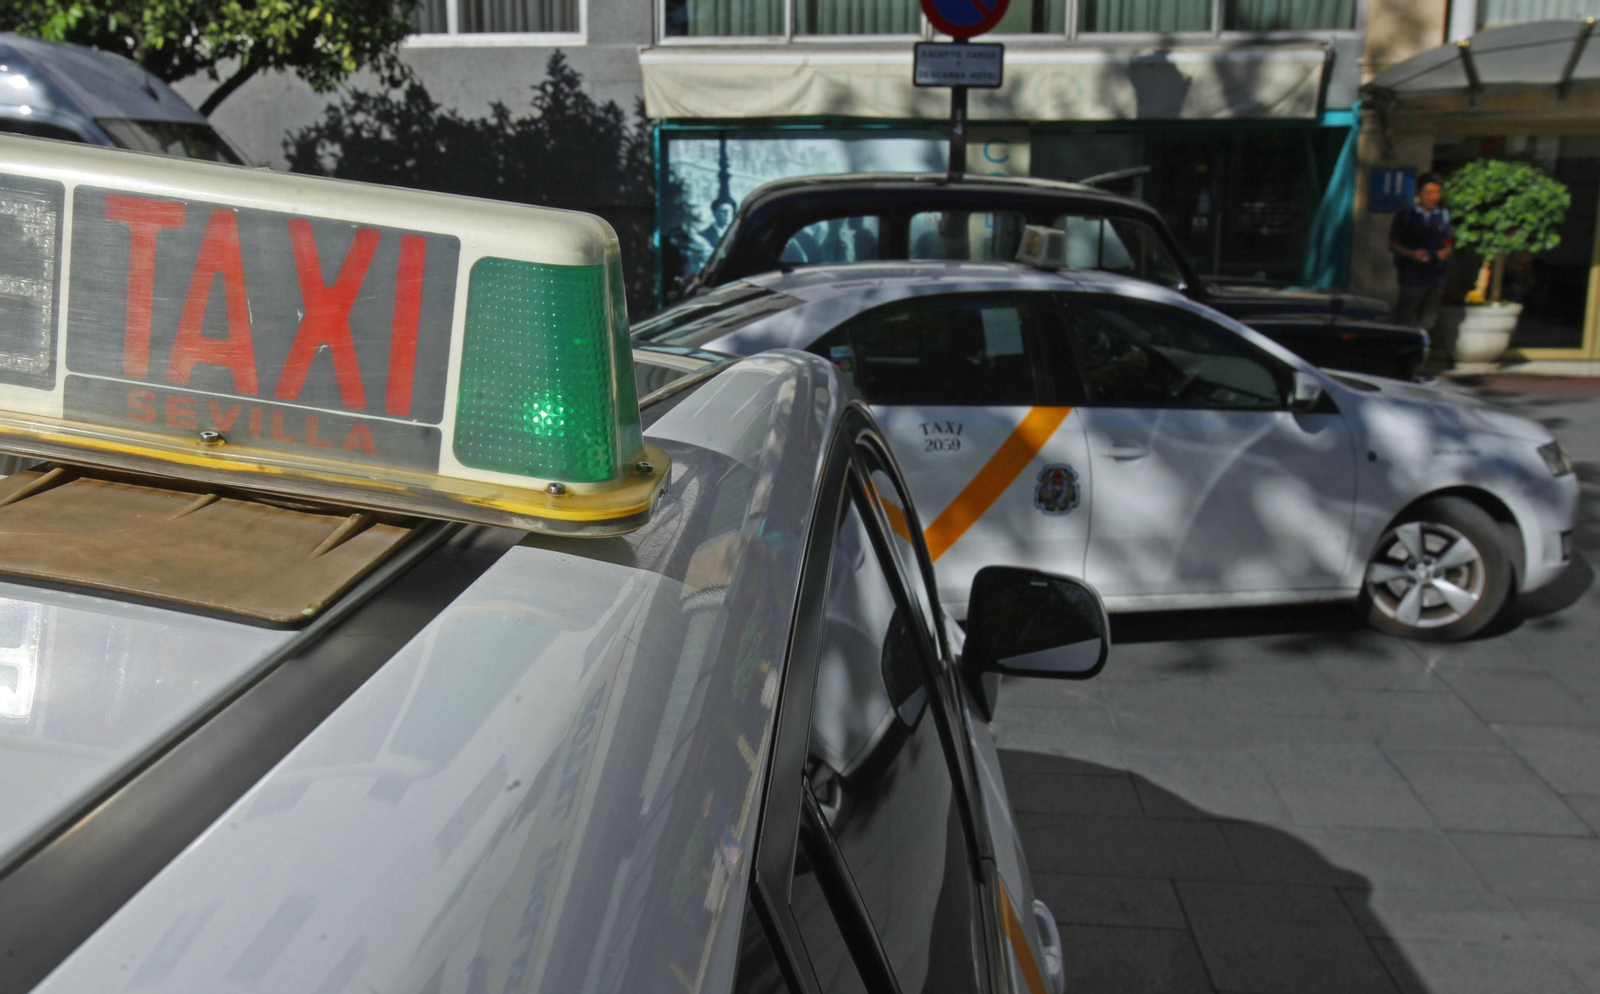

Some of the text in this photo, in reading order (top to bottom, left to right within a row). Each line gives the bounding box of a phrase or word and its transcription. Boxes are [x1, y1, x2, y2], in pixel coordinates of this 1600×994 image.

[105, 194, 426, 416] TAXI
[125, 389, 378, 456] SEVILLA
[918, 421, 963, 436] TAXI
[925, 438, 961, 452] 2059
